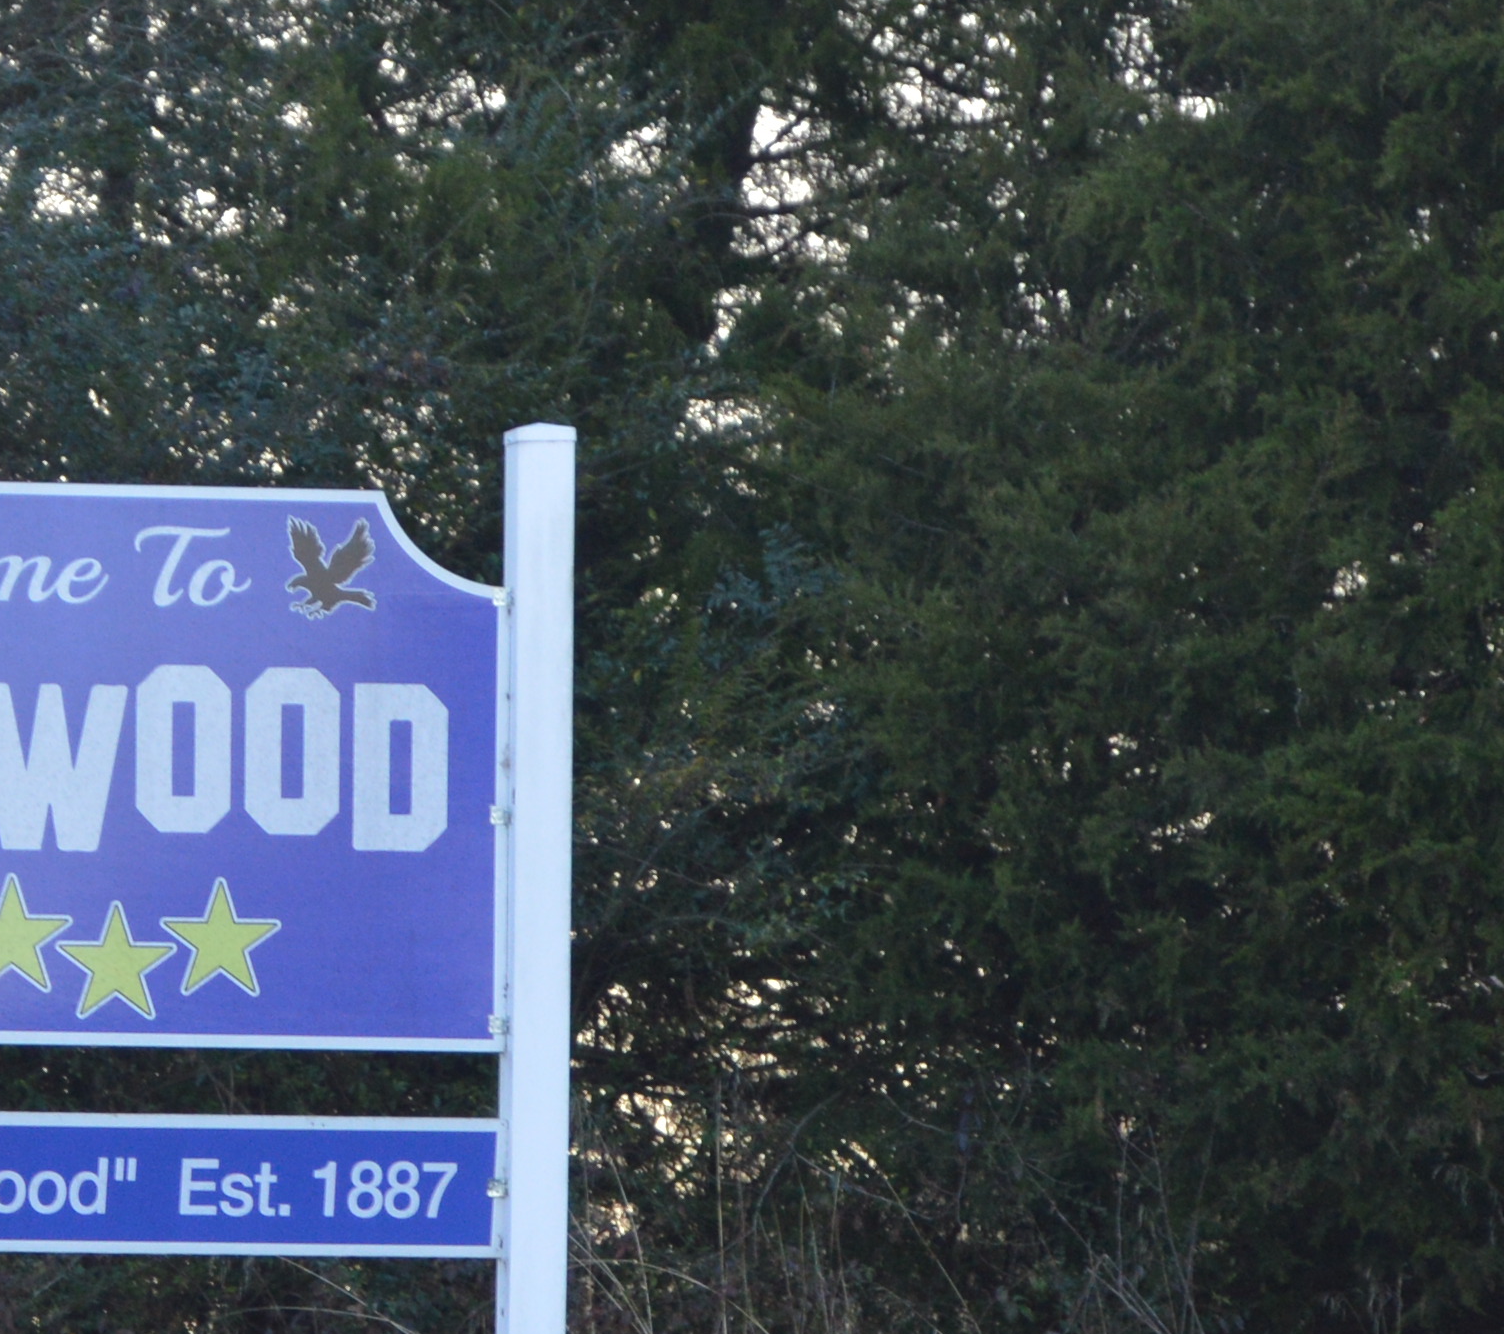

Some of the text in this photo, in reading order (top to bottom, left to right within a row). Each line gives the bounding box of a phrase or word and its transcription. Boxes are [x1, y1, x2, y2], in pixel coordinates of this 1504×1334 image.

[133, 525, 252, 607] To
[178, 1157, 292, 1218] Est.
[312, 1159, 458, 1220] 1887
